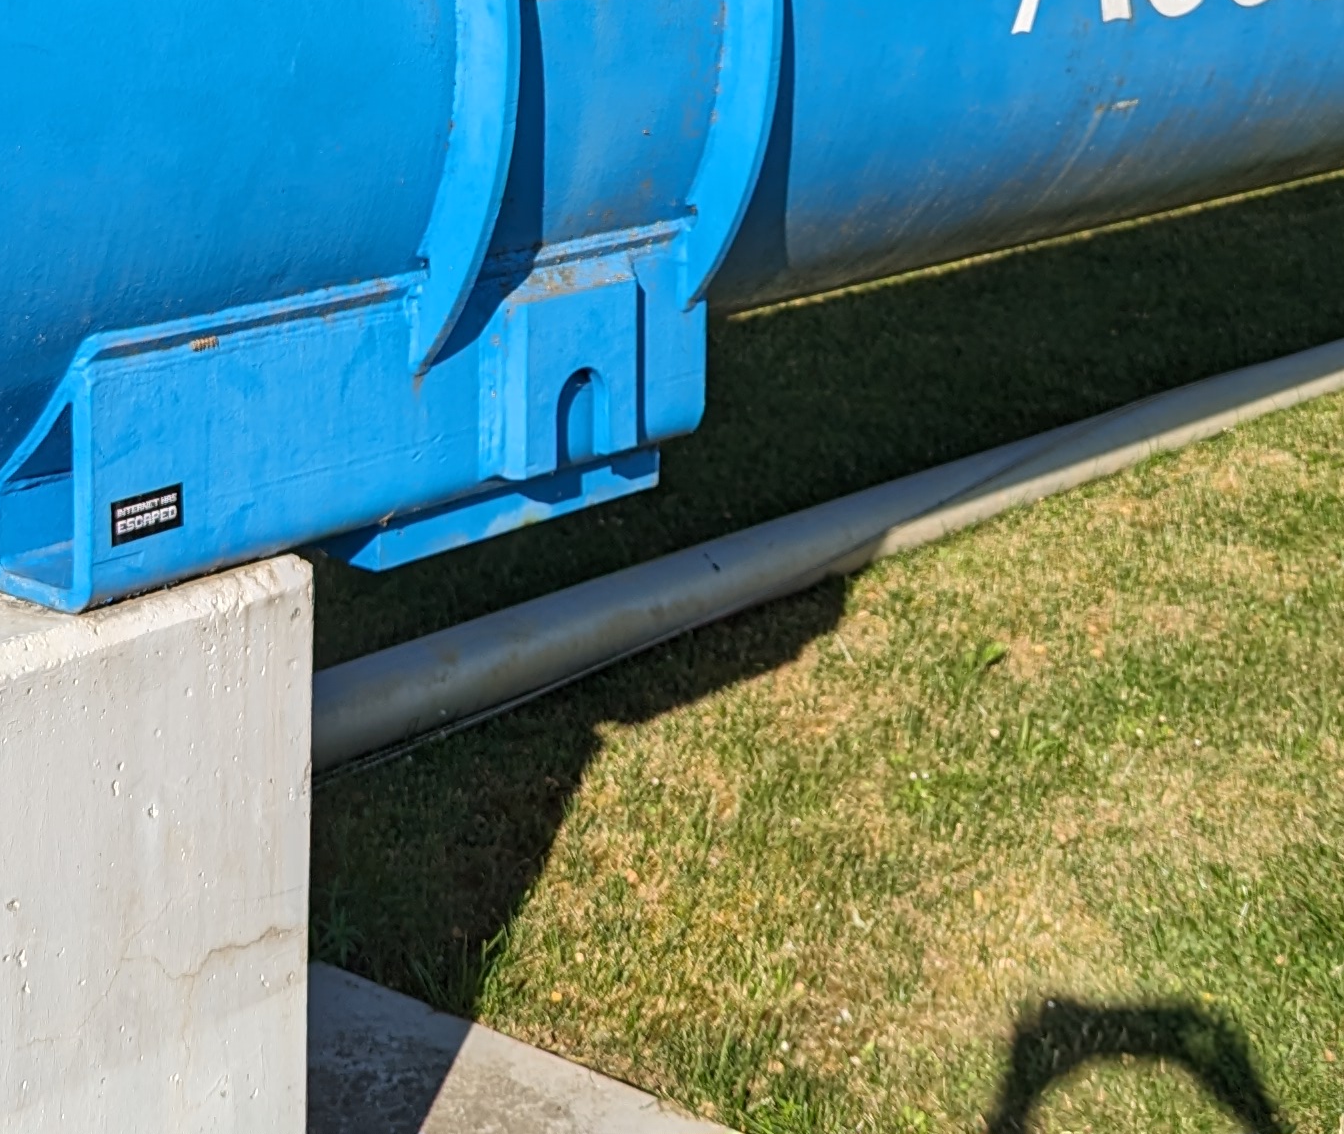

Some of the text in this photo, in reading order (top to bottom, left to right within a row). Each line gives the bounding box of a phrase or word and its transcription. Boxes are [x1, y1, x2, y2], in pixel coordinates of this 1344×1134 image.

[116, 492, 178, 518] INTERNET HAS
[116, 504, 177, 535] ESCAPED
